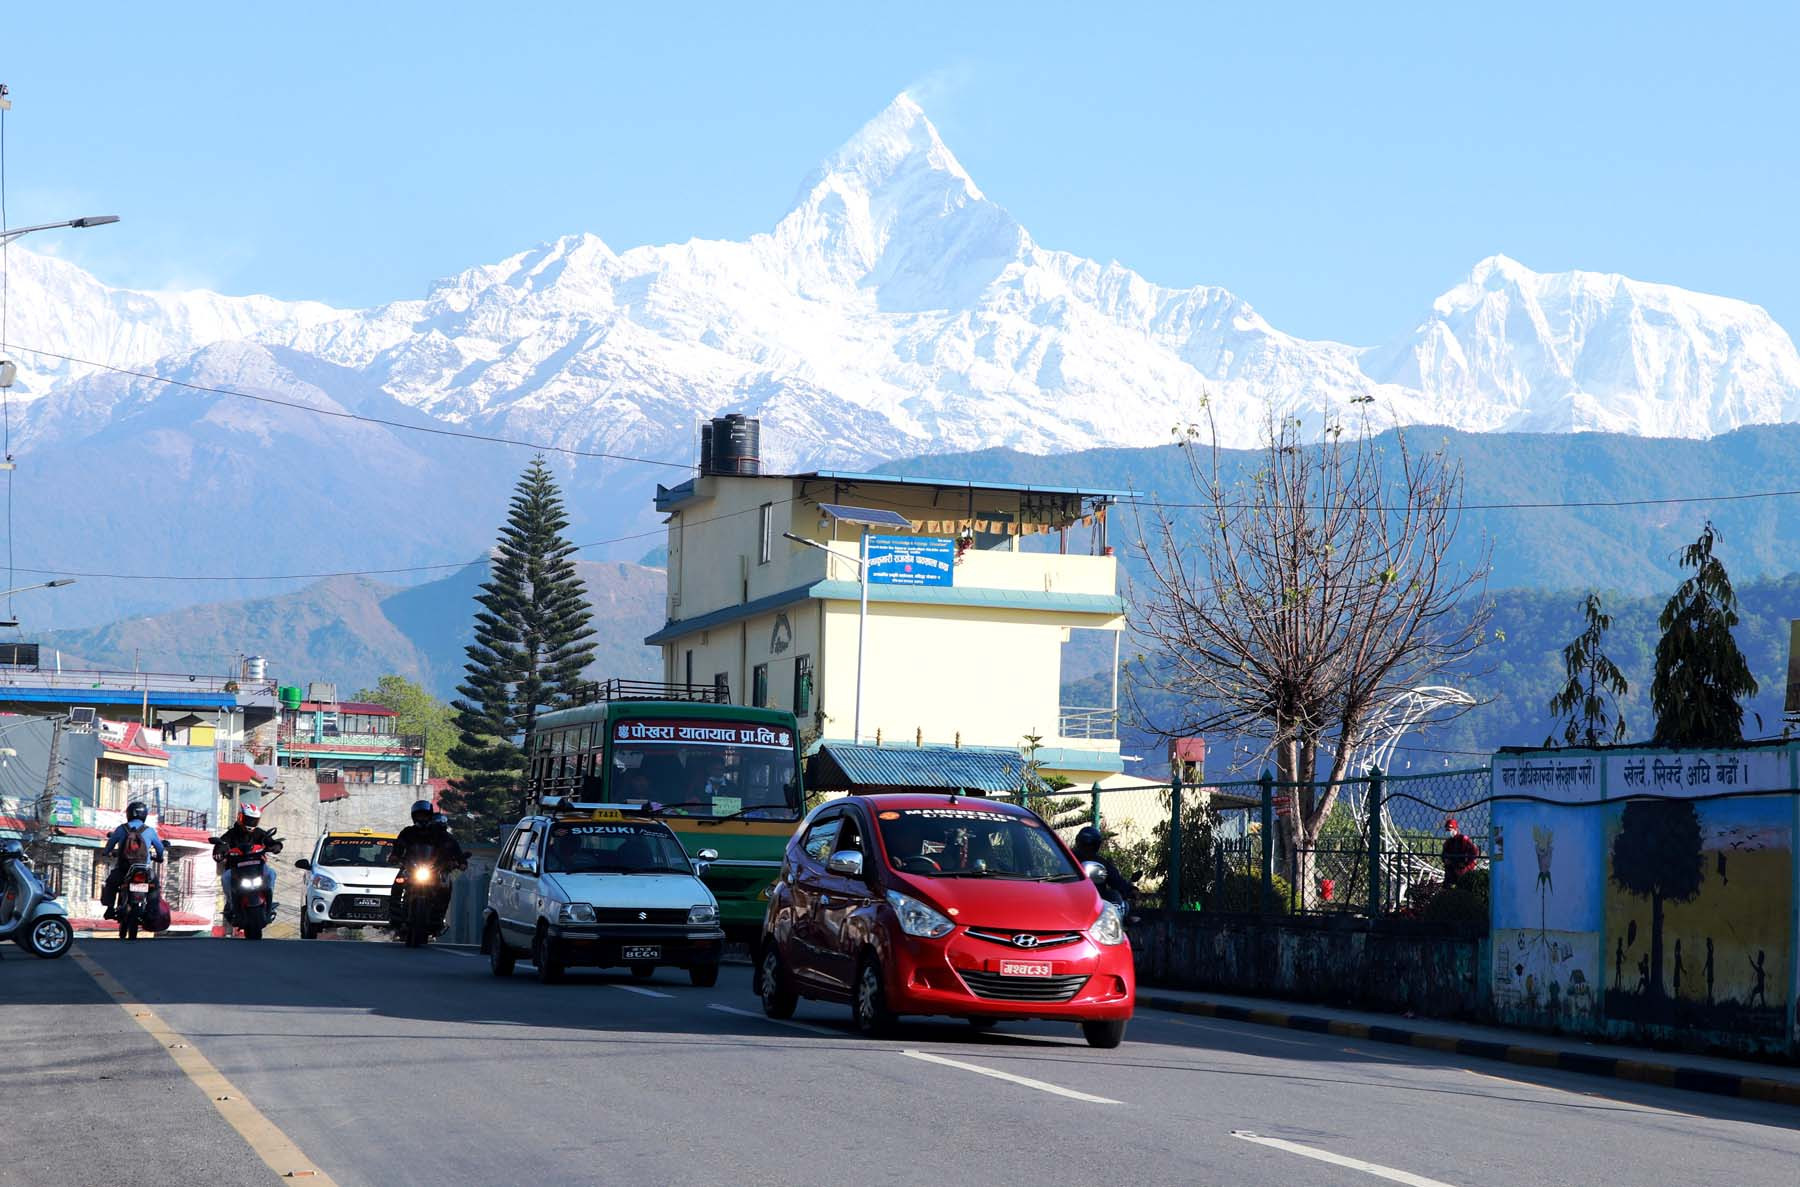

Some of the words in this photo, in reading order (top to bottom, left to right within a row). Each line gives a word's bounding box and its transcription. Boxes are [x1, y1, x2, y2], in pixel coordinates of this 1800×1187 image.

[632, 722, 674, 739] पोखरा
[678, 727, 737, 742] यातायात
[1687, 758, 1711, 786] अघि
[571, 826, 635, 835] SUZUKI
[346, 912, 385, 920] SUZUK
